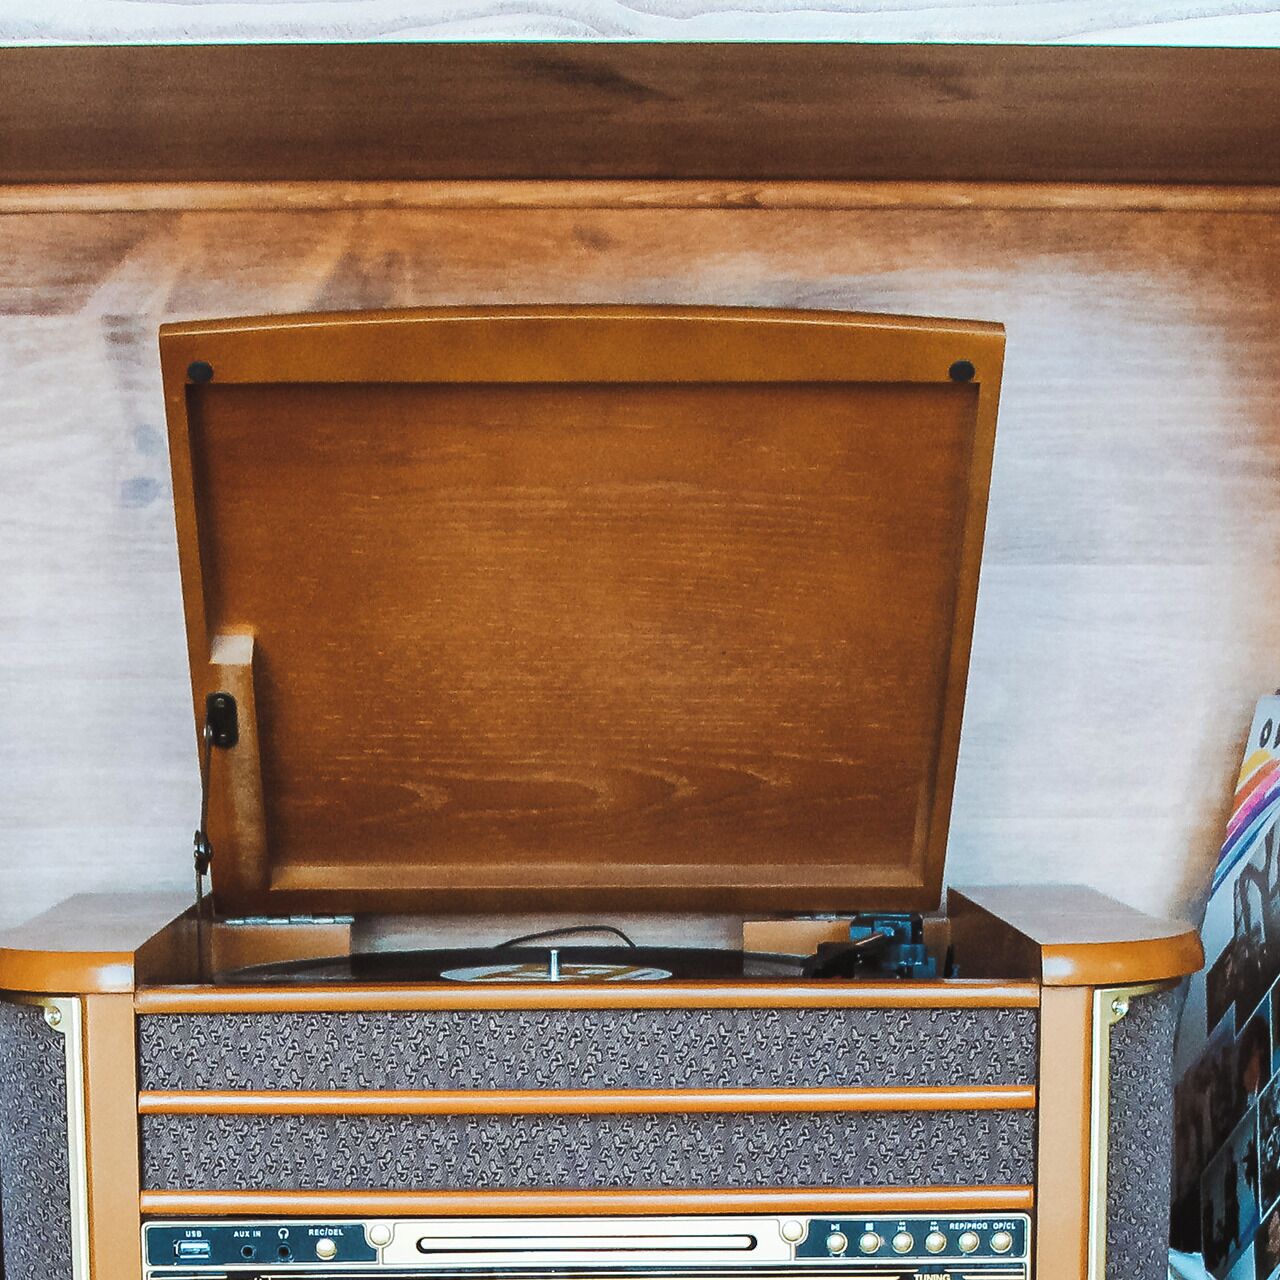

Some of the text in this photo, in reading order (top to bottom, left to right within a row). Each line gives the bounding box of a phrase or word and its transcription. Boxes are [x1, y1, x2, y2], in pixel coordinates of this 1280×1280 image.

[1259, 718, 1273, 748] O
[185, 1230, 202, 1238] USB
[233, 1230, 250, 1238] AUX
